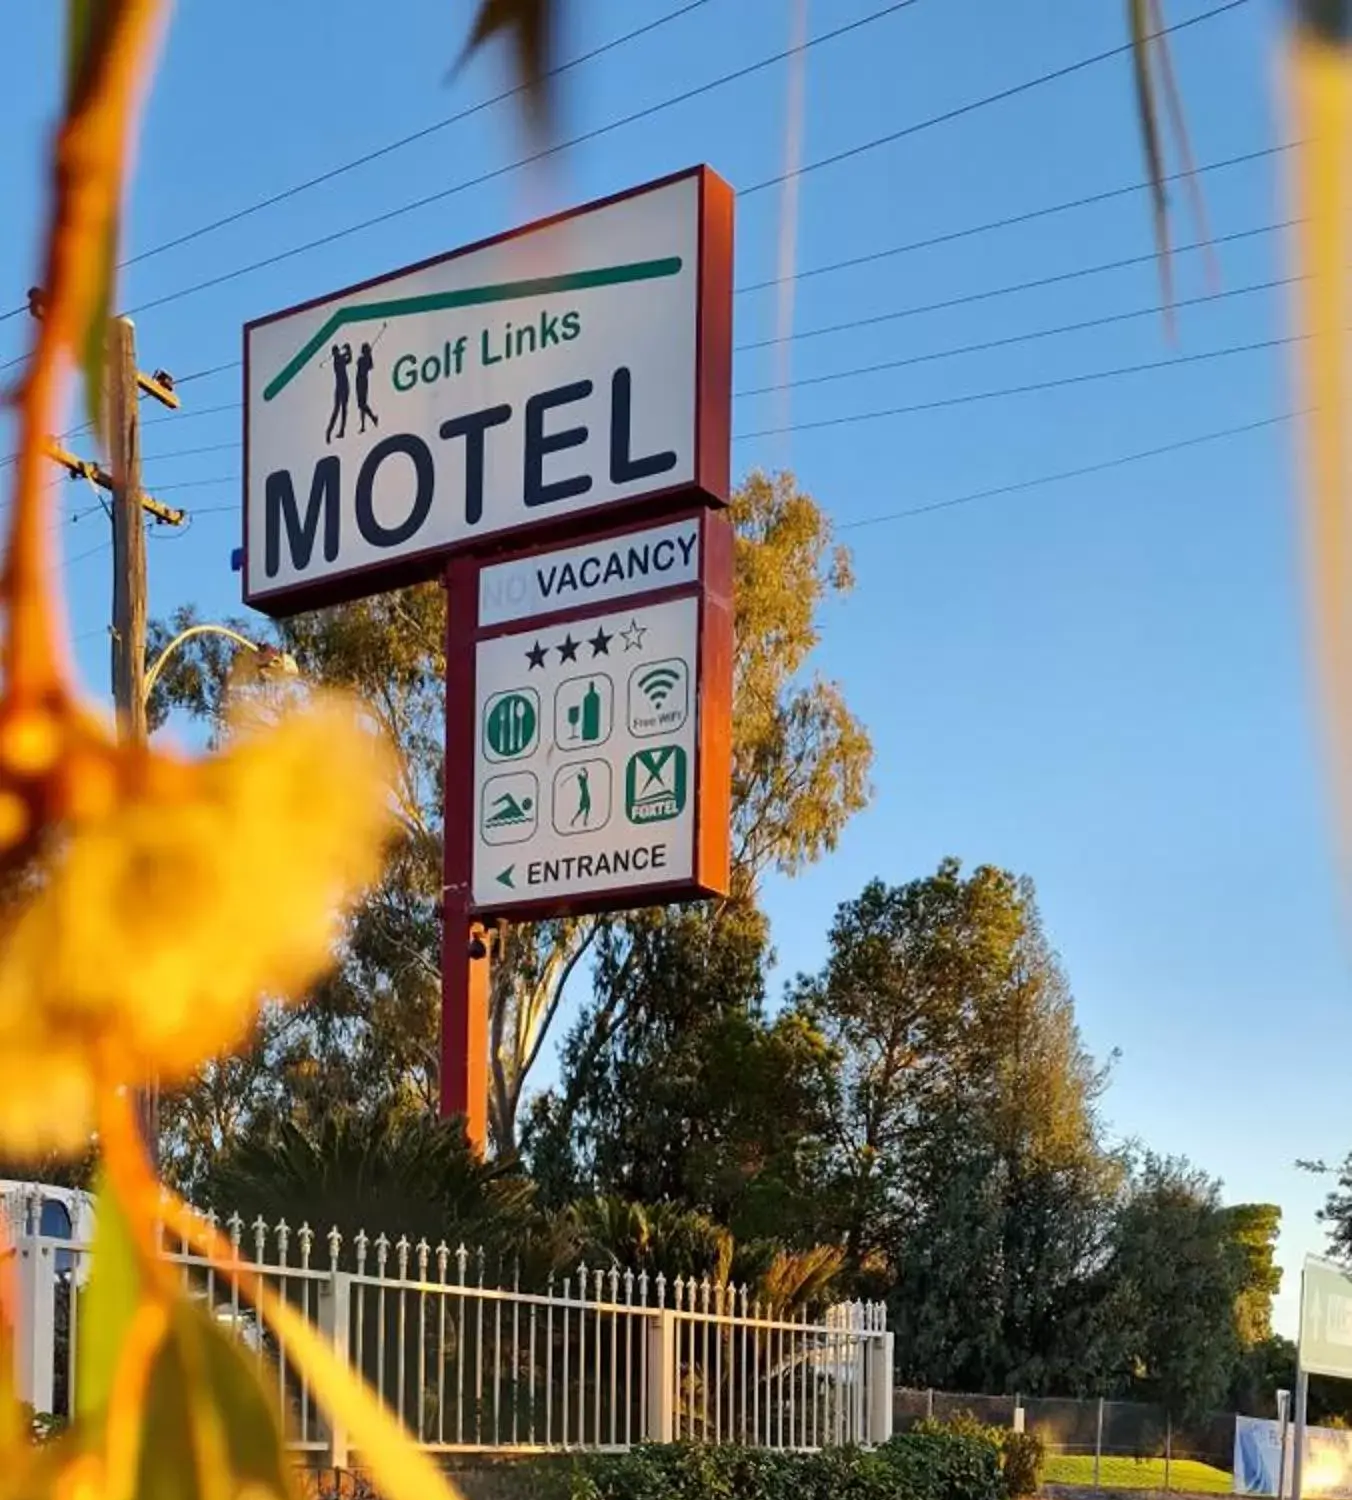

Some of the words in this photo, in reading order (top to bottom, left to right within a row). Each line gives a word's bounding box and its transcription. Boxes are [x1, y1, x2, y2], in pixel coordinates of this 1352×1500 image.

[392, 337, 467, 392] Golf
[482, 310, 581, 367] Links
[265, 366, 677, 578] MOTEL
[536, 532, 697, 598] VACANCY
[633, 717, 656, 730] Free
[631, 799, 679, 820] FOXTEL
[527, 843, 667, 886] ENTRANCE
